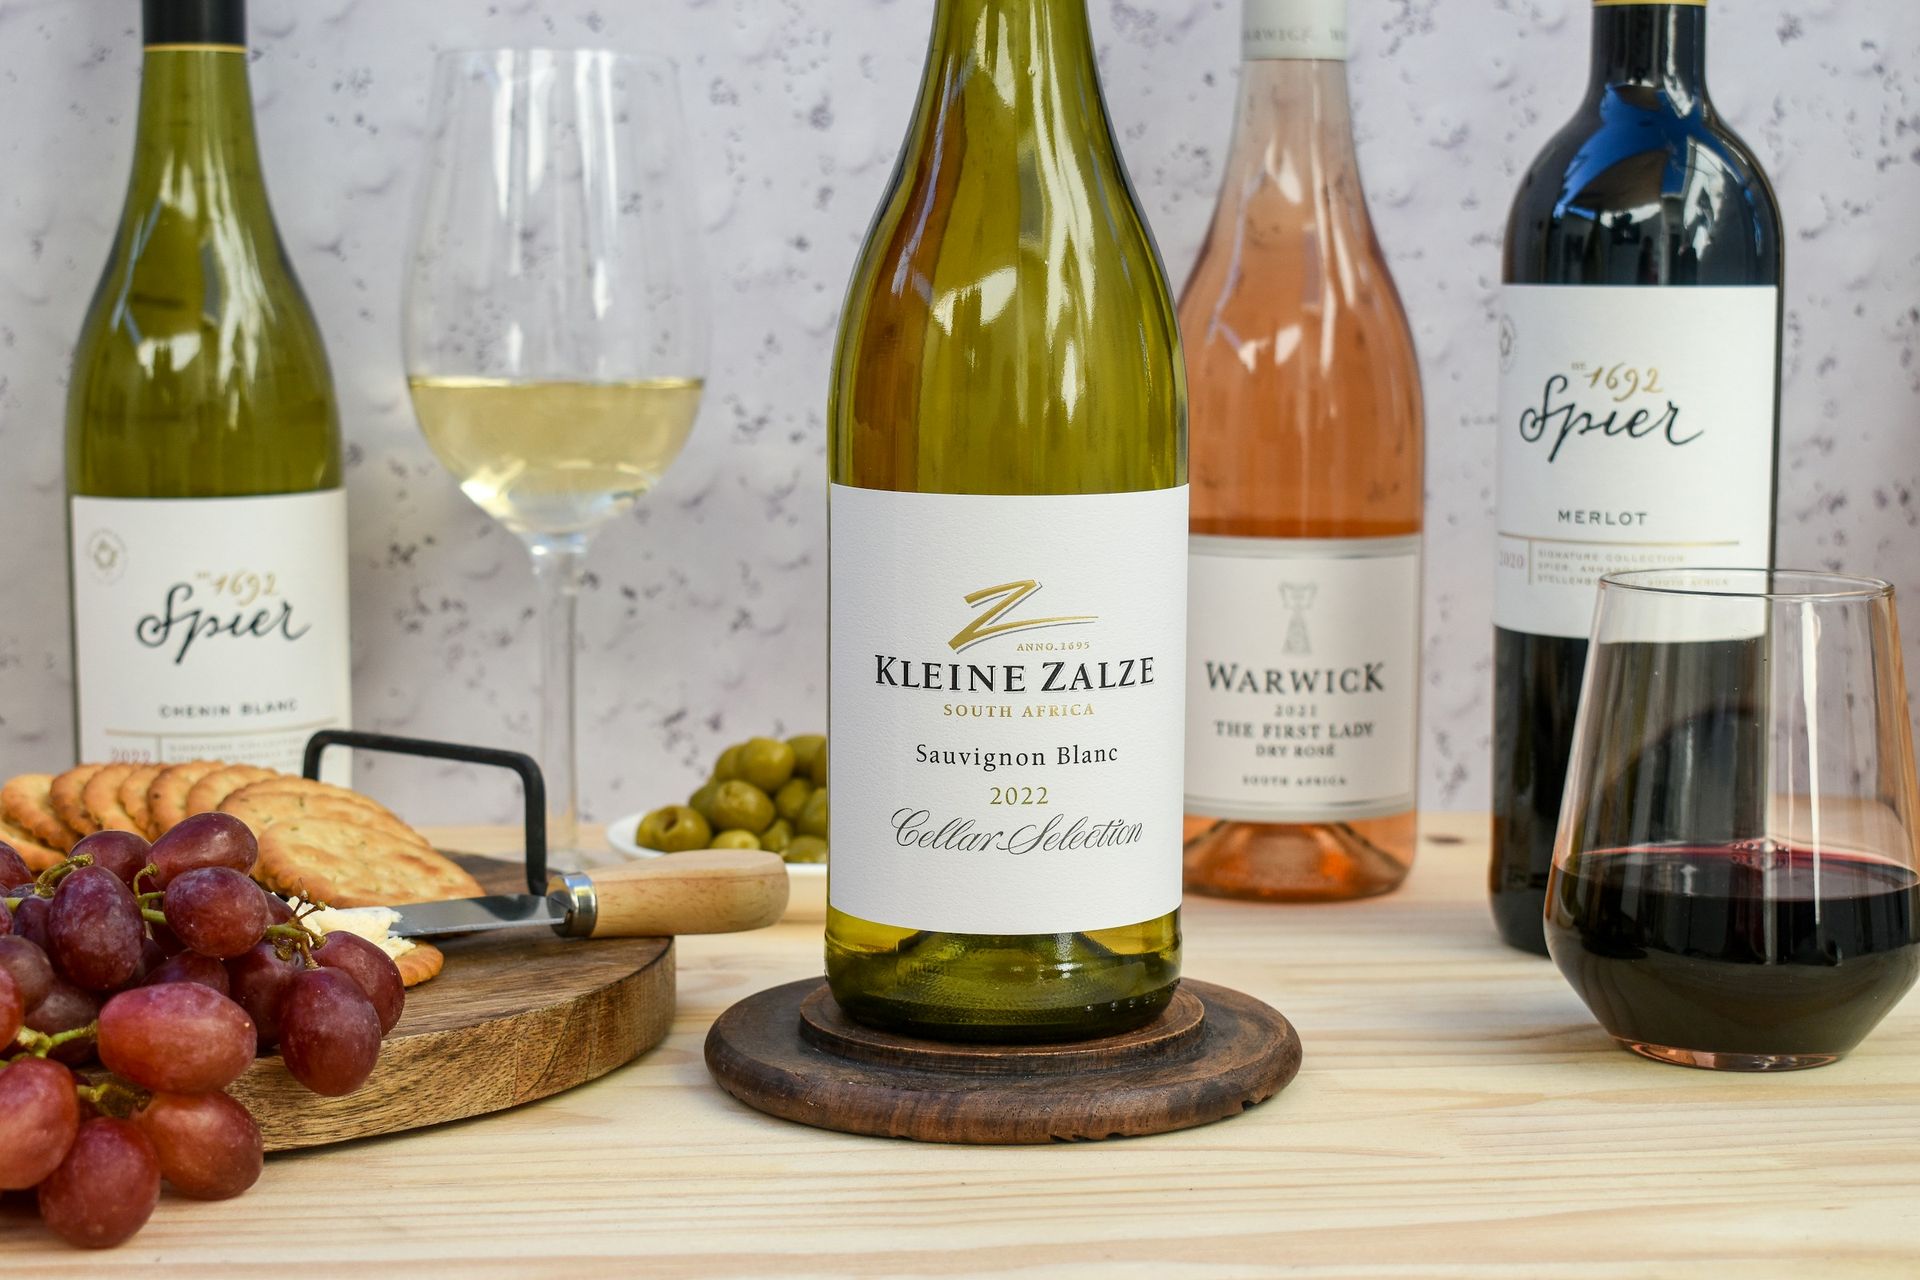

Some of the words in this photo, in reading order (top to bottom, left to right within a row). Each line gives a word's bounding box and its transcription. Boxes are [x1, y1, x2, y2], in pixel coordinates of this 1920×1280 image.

[1584, 362, 1664, 402] 1692
[1519, 374, 1705, 464] Spier
[1557, 509, 1649, 526] MERLOT
[135, 582, 312, 666] Spier
[874, 654, 1027, 693] KLEINE
[1040, 656, 1155, 693] ZALZE
[1205, 660, 1385, 695] WARWICK
[158, 704, 231, 719] CHENIN
[240, 699, 299, 717] BLANC
[943, 703, 1013, 718] SOUTH
[1021, 703, 1095, 718] AFRICA
[1214, 720, 1254, 737] THE
[1262, 722, 1321, 740] FIRST
[1328, 721, 1376, 739] LADY
[915, 743, 1046, 772] Sauvignon
[1056, 744, 1119, 765] Blanc
[1255, 745, 1288, 757] DRY
[989, 786, 1050, 806] 2022
[890, 807, 1004, 852] Cellar
[999, 812, 1144, 856] Selection
